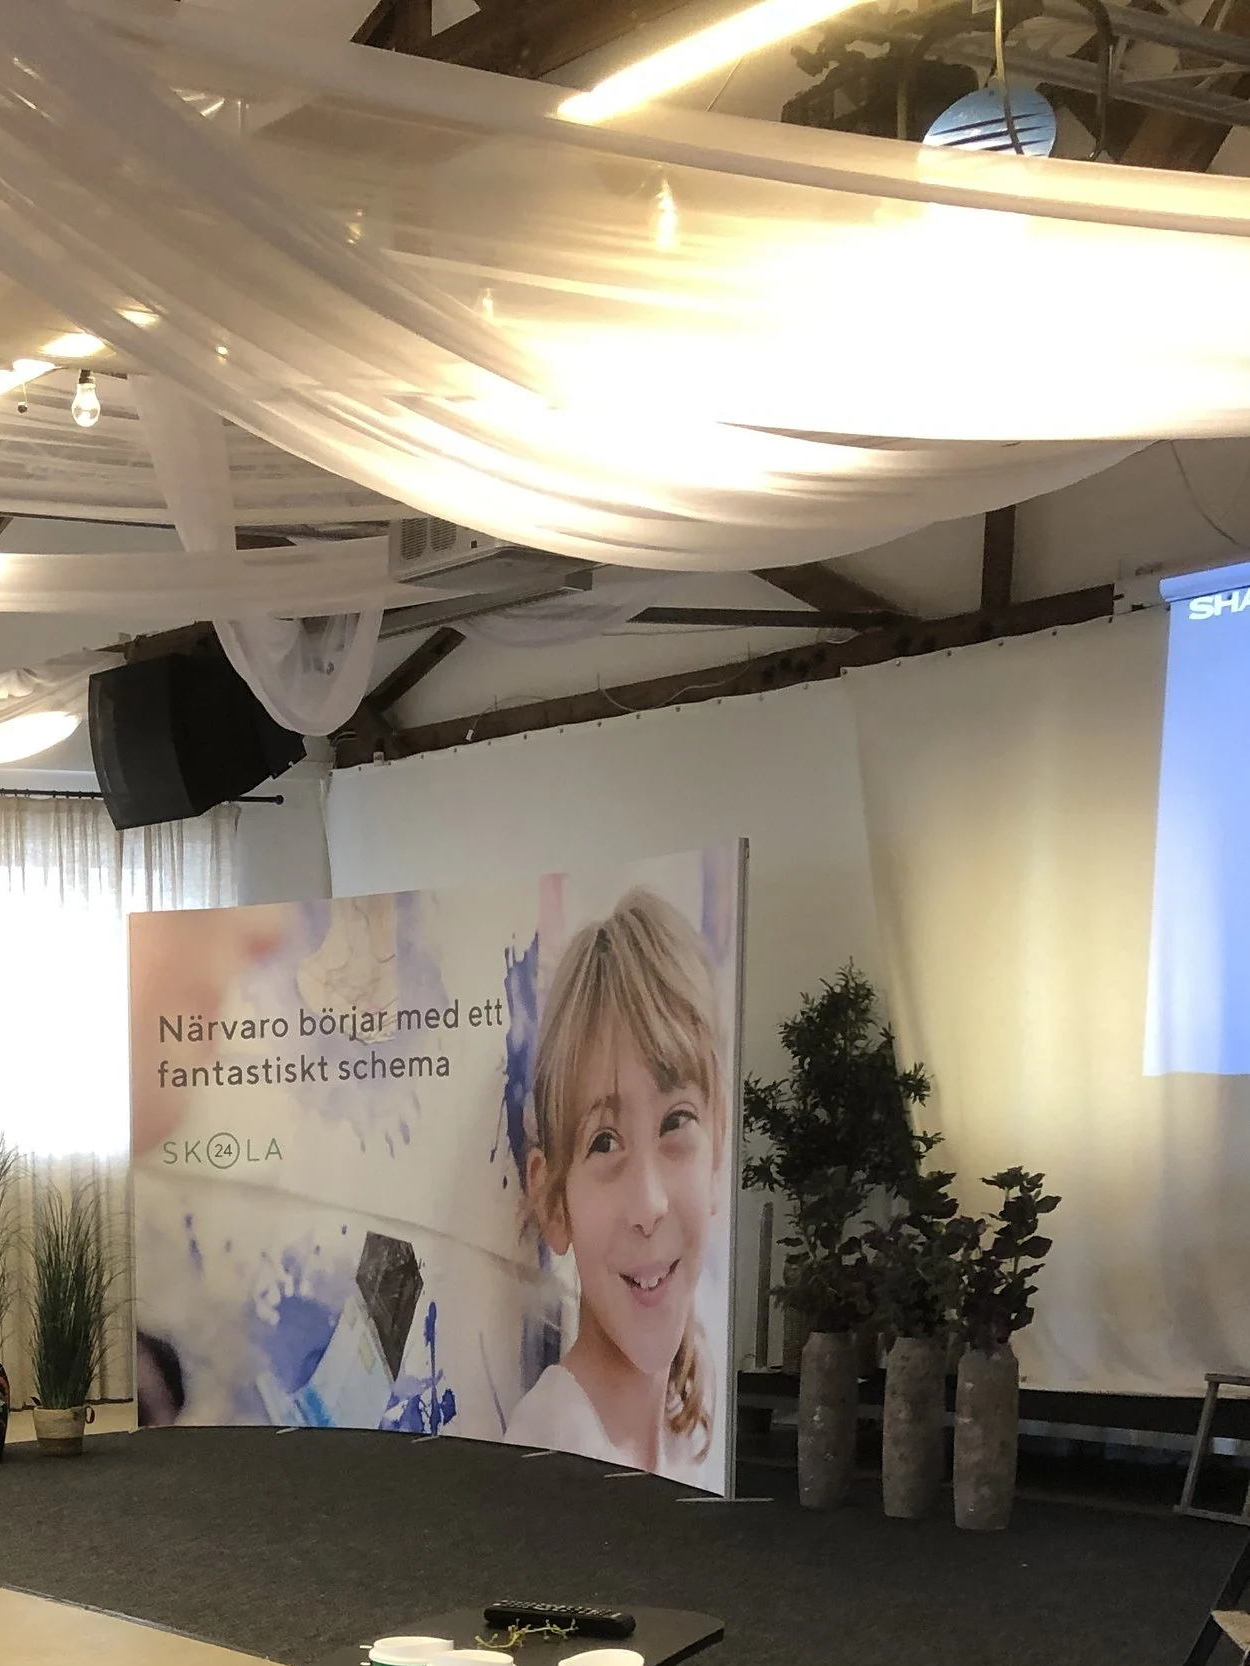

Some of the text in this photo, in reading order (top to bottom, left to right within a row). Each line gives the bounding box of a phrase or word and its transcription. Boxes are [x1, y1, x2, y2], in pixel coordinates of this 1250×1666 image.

[158, 998, 503, 1044] Närvaro börjar med ett
[157, 1051, 450, 1088] fantastiskt schema
